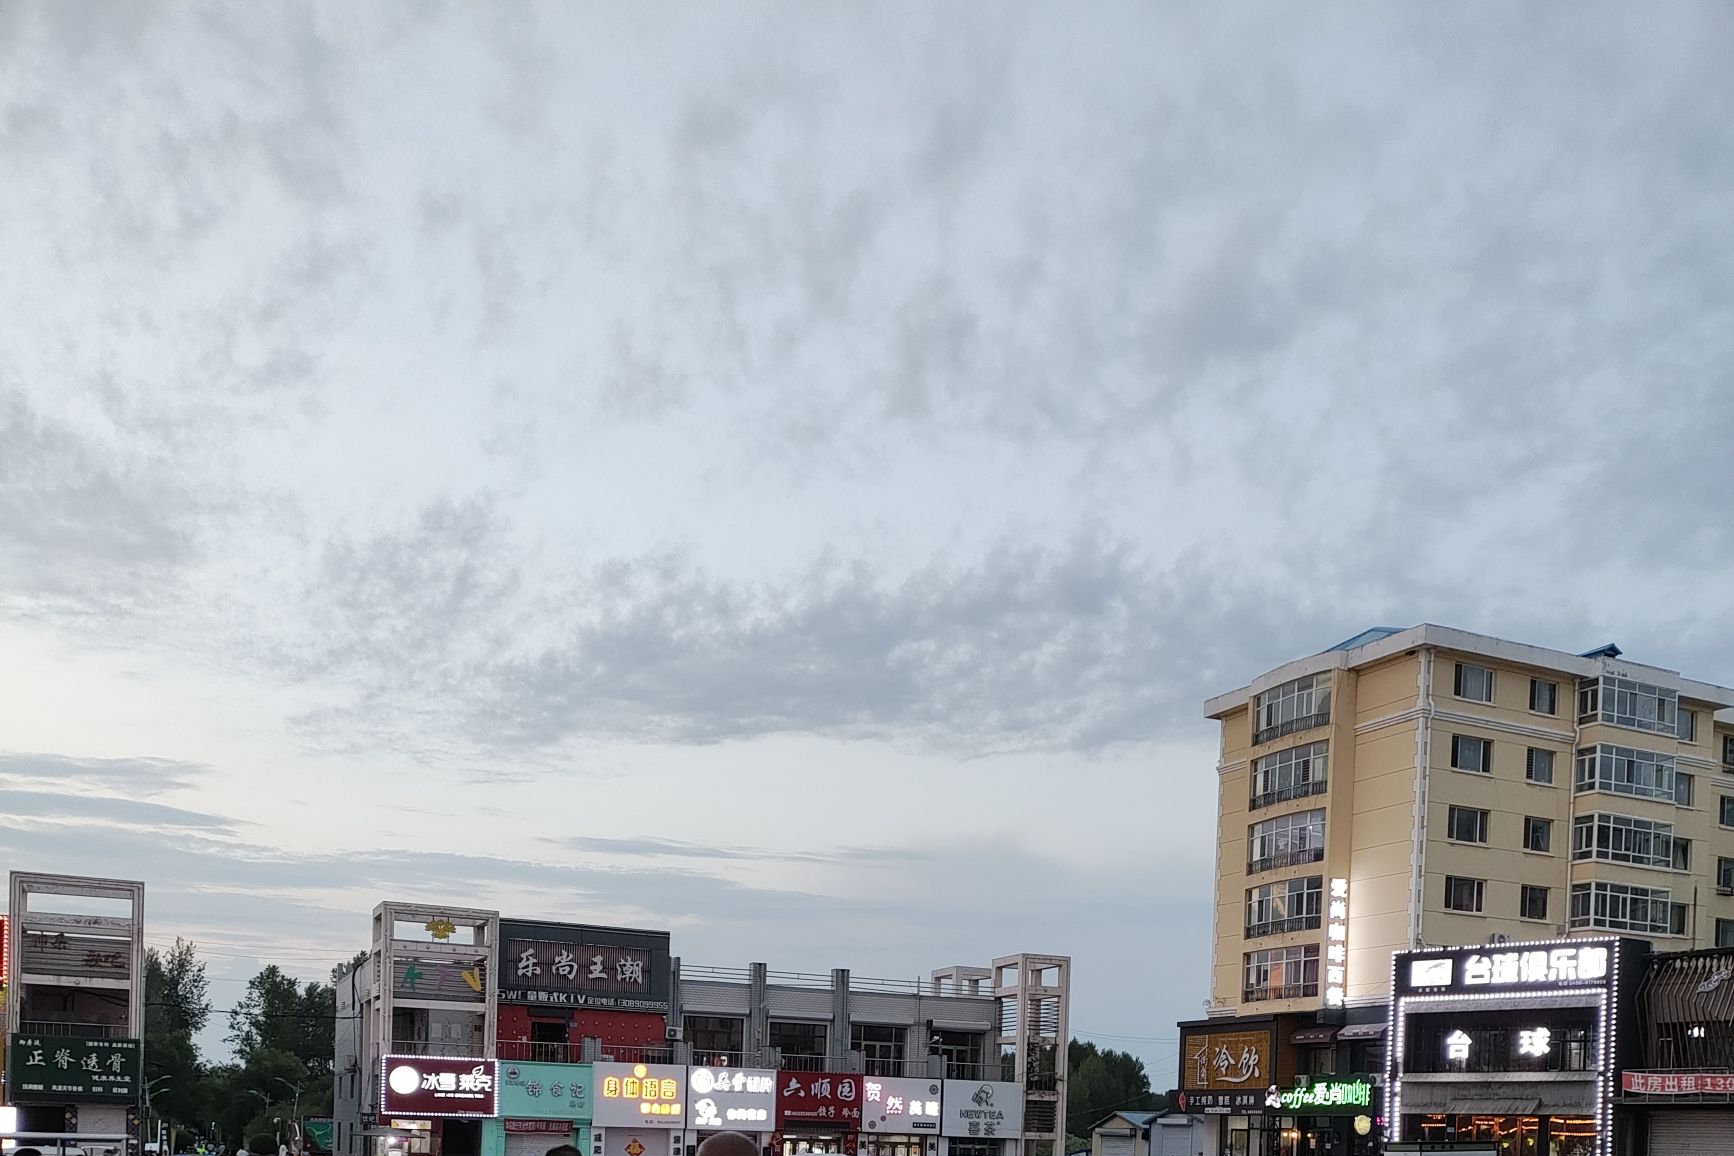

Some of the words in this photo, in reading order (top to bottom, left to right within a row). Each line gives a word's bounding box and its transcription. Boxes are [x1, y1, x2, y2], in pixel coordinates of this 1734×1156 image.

[1448, 1027, 1550, 1058] 台球
[25, 1048, 126, 1073] 正脊透骨
[1213, 1044, 1260, 1082] 冷饮
[604, 1077, 676, 1099] 身体语言
[783, 1077, 856, 1101] 六顺园
[1281, 1088, 1315, 1109] coffee
[960, 1109, 1004, 1120] NEWTEA
[968, 1121, 996, 1136] 喜茶
